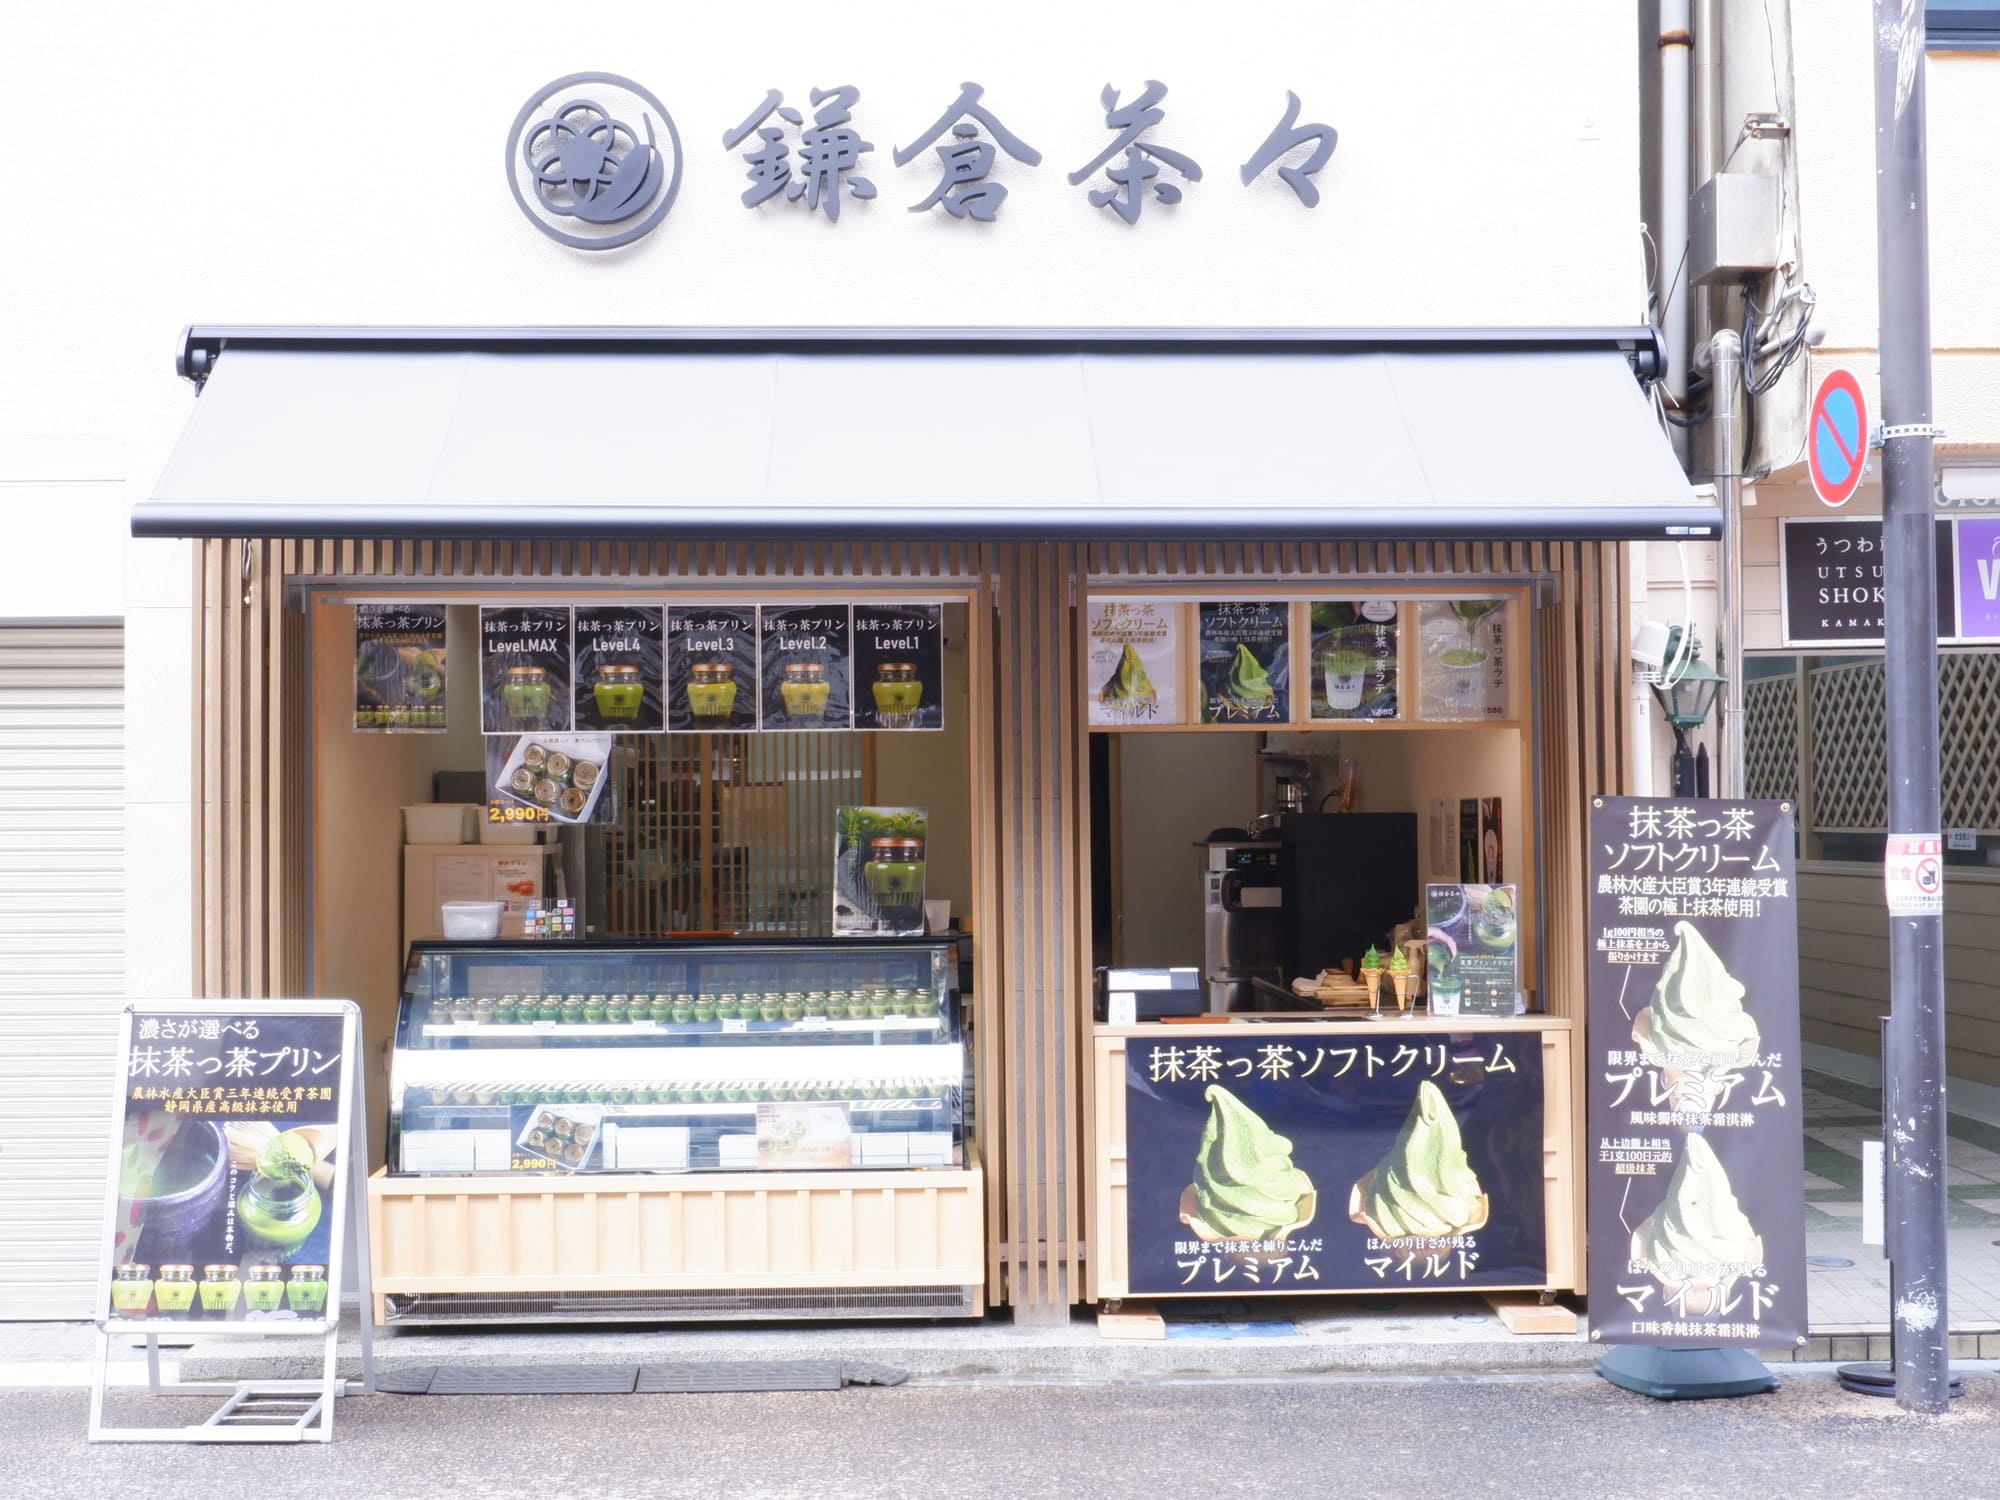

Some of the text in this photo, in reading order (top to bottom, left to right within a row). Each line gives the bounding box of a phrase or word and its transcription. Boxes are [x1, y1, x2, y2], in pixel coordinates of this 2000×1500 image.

[722, 80, 1340, 225] 鎌倉茶々
[1815, 536, 1884, 555] うつわ
[484, 620, 567, 633] 抹茶っ茶プリン
[577, 620, 660, 632] 抹茶っ茶プリン
[670, 619, 753, 632] 抹茶っ茶プリン
[763, 619, 846, 631] 抹茶っ茶プリン
[855, 619, 938, 631] 抹茶っ茶プリン
[1204, 617, 1283, 629] ソフトクリーム
[489, 638, 558, 654] Level.MAX
[592, 637, 641, 653] Level.4
[687, 637, 735, 652] Level.3
[779, 635, 827, 651] Level.2
[875, 635, 919, 650] Level.1
[489, 807, 549, 822] 2,990円
[1629, 805, 1756, 841] 抹茶っ茶
[1605, 842, 1781, 874] ソフトクリーム
[1597, 874, 1789, 898] 農林水産大臣賞3年連続受賞
[138, 1018, 260, 1040] 濃さが選べる
[128, 1045, 341, 1078] 抹茶っ茶プリン
[1149, 1043, 1517, 1082] 抹茶っ茶ソフトクリーム
[1605, 1068, 1787, 1109] プレミアム
[512, 1158, 556, 1170] 2,990円
[1173, 1238, 1323, 1255] 限界まで抹茶を練りこんだ
[1366, 1236, 1477, 1251] ほんのり甘さが残る
[1176, 1255, 1320, 1286] プレミアム
[1363, 1250, 1480, 1281] マイルド
[1616, 1279, 1780, 1321] マイルド
